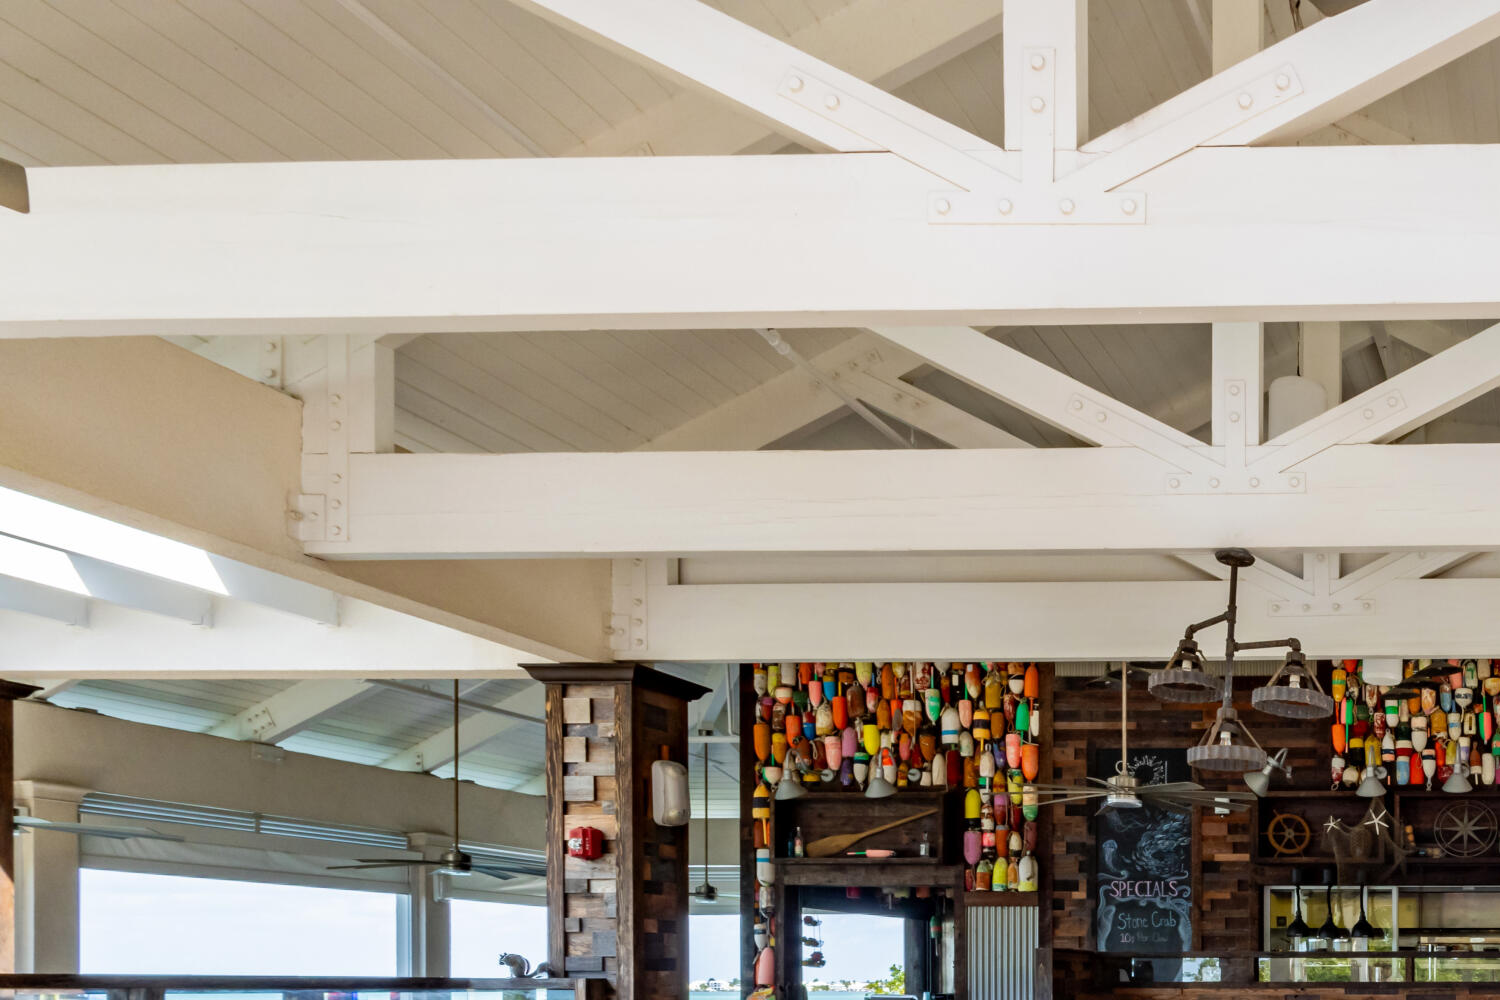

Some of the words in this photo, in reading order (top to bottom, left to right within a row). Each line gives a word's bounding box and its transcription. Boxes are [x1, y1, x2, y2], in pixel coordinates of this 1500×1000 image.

[1109, 880, 1178, 897] SPECIALS
[1117, 912, 1149, 930] Stone
[1151, 910, 1177, 928] Crab
